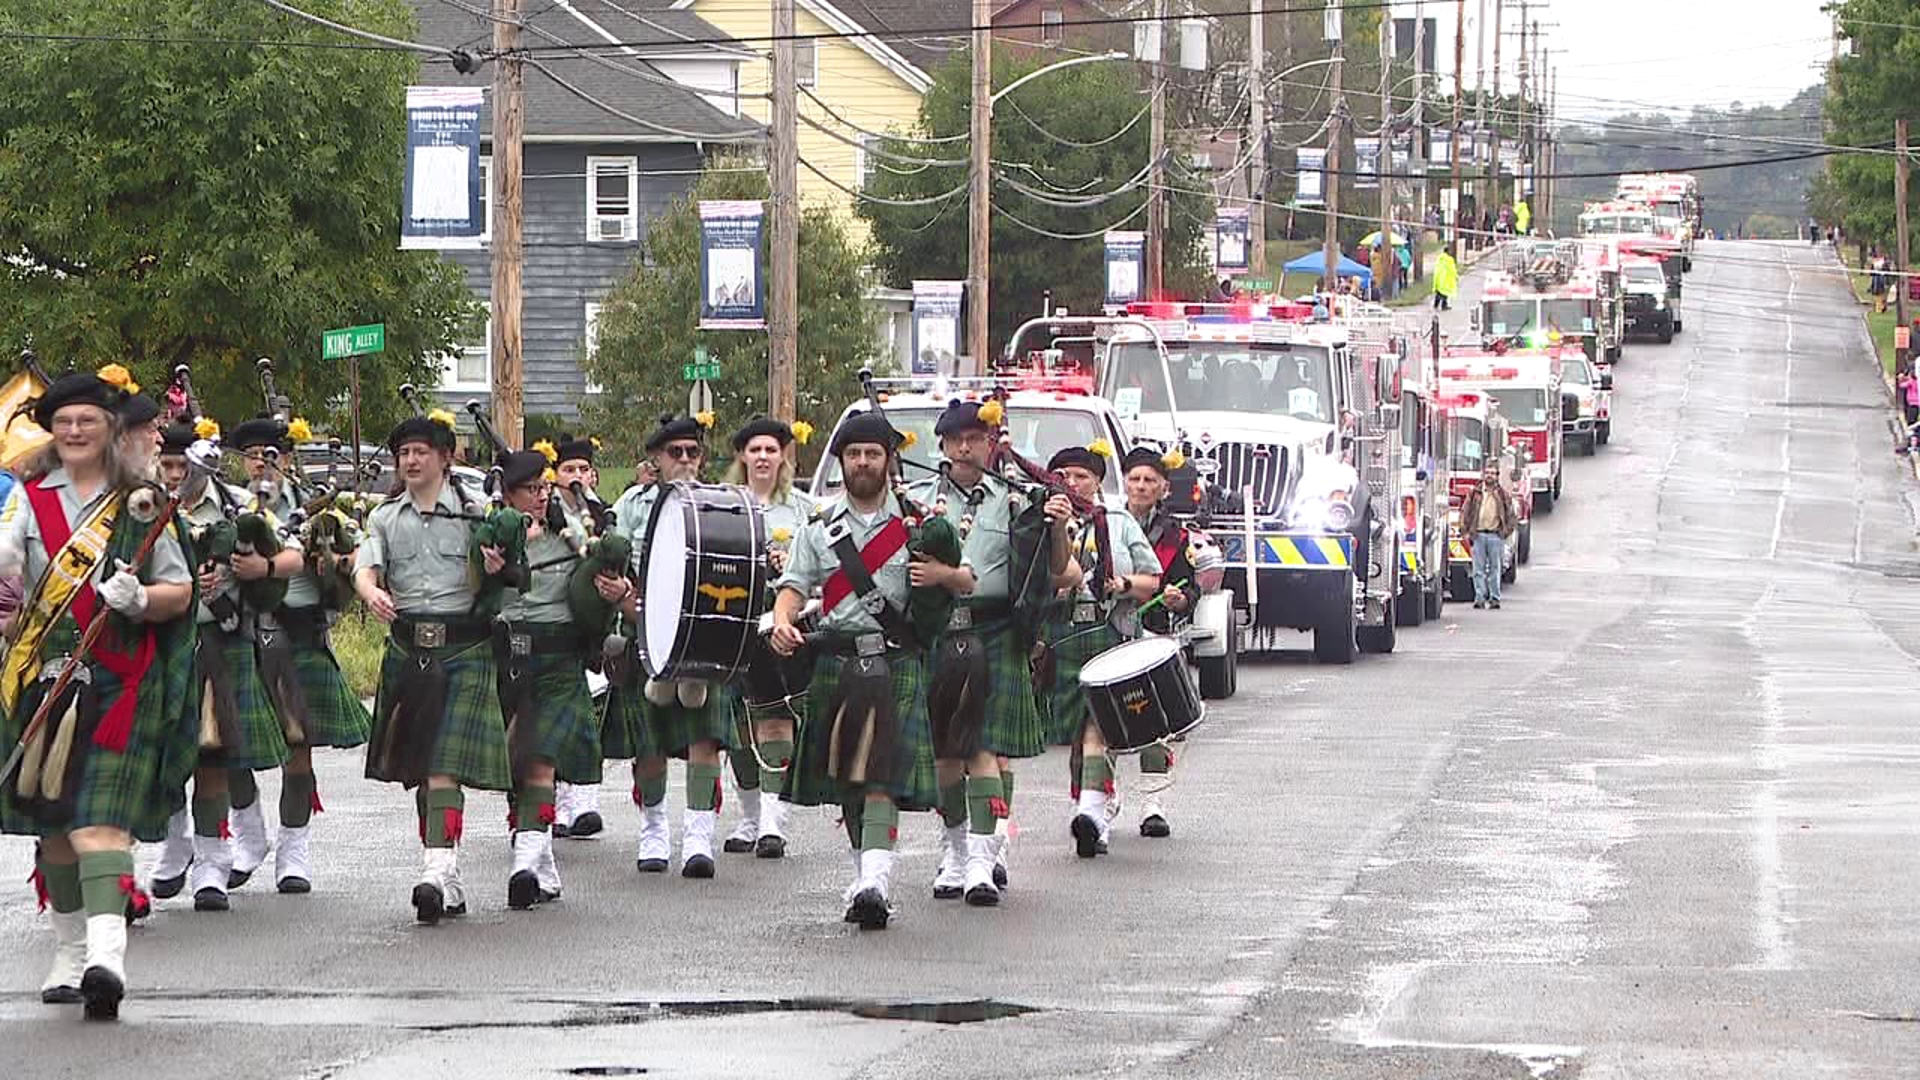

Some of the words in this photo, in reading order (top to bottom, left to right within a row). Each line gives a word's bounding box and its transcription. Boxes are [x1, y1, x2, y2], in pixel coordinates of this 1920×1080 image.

[326, 332, 352, 355] KING
[356, 332, 379, 349] ALLEY
[685, 366, 691, 379] S
[711, 364, 720, 379] ST
[712, 561, 737, 574] HMH
